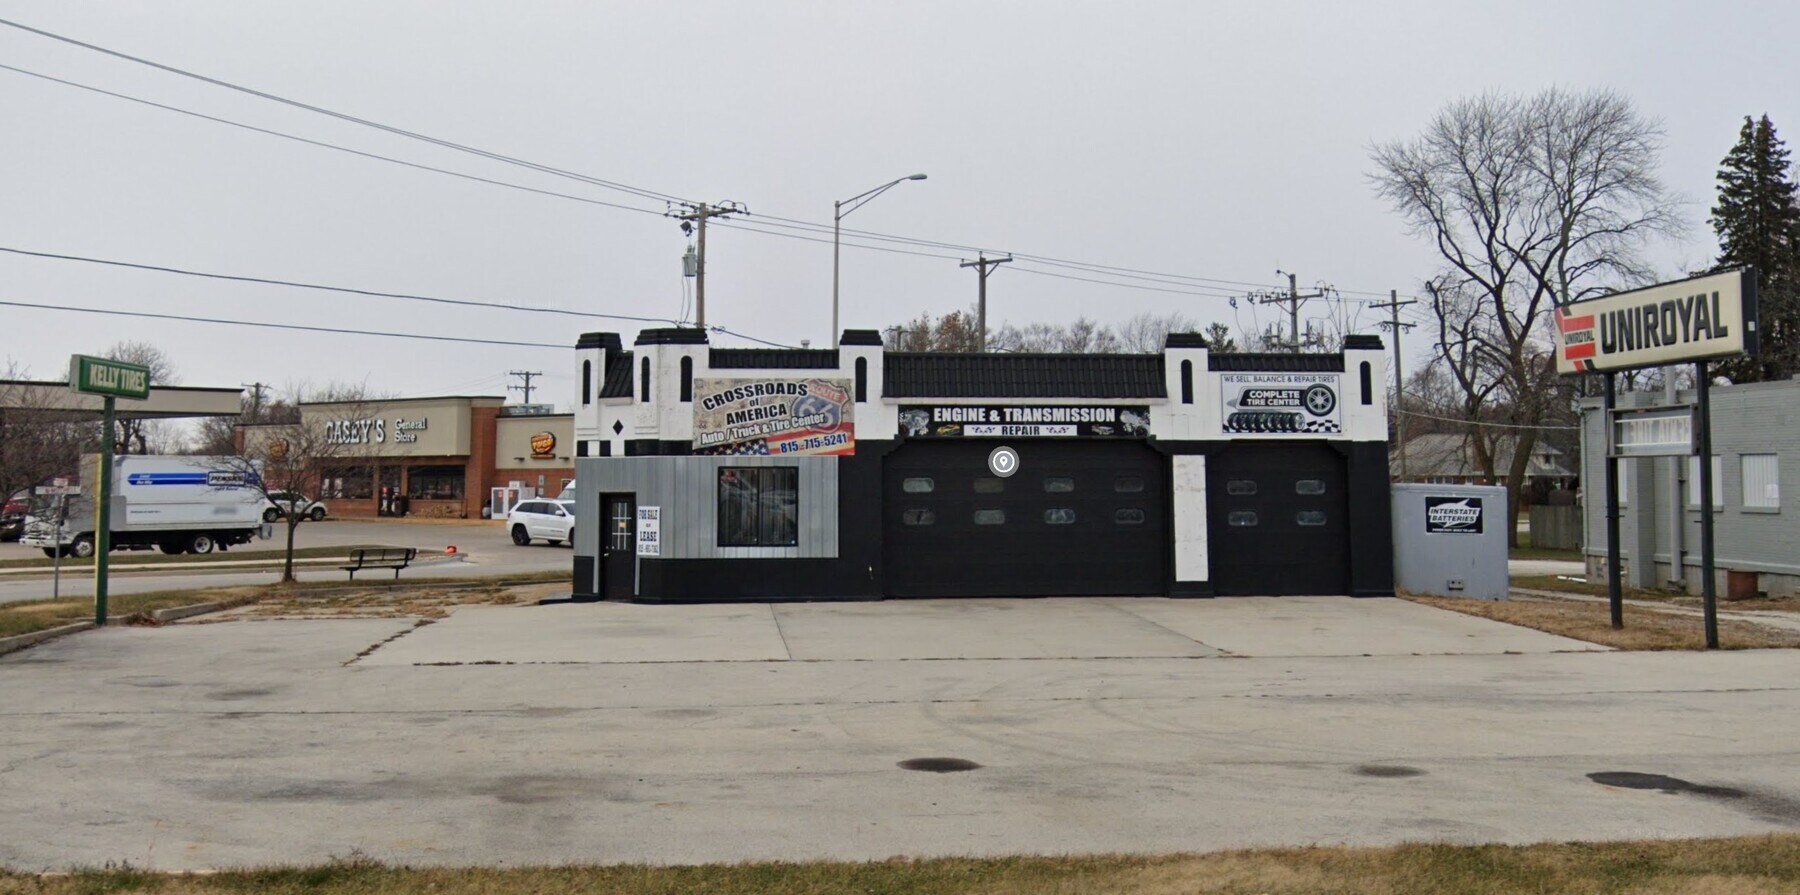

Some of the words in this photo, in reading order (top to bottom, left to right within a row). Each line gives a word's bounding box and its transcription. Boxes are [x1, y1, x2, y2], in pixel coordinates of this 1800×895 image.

[1600, 290, 1728, 354] UNIROYAL
[1564, 330, 1595, 345] UNIROYAL
[90, 363, 120, 388] KELLY
[121, 368, 146, 392] TIRES
[1223, 375, 1234, 383] WE
[1254, 375, 1285, 383] BALANCE
[1287, 375, 1292, 383] &
[1294, 375, 1316, 383] REPAIR
[1318, 375, 1335, 383] TIRES
[702, 382, 808, 411] CROSSROADS
[808, 383, 841, 399] ROUTE
[1249, 390, 1300, 398] COMPLETE
[726, 404, 787, 425] AMERICA
[800, 400, 833, 428] 66
[933, 407, 986, 422] ENGINE
[989, 409, 1001, 422] &
[1003, 407, 1116, 422] TRANSMISSION
[326, 419, 385, 443] CASEY'S
[394, 417, 427, 430] General
[701, 432, 724, 445] Auto
[731, 425, 760, 439] Truck
[761, 424, 770, 433] &
[770, 419, 790, 432] Tire
[791, 412, 825, 428] Center
[1001, 425, 1040, 436] REPAIR
[394, 430, 417, 443] Store
[640, 531, 657, 541] LEASE
